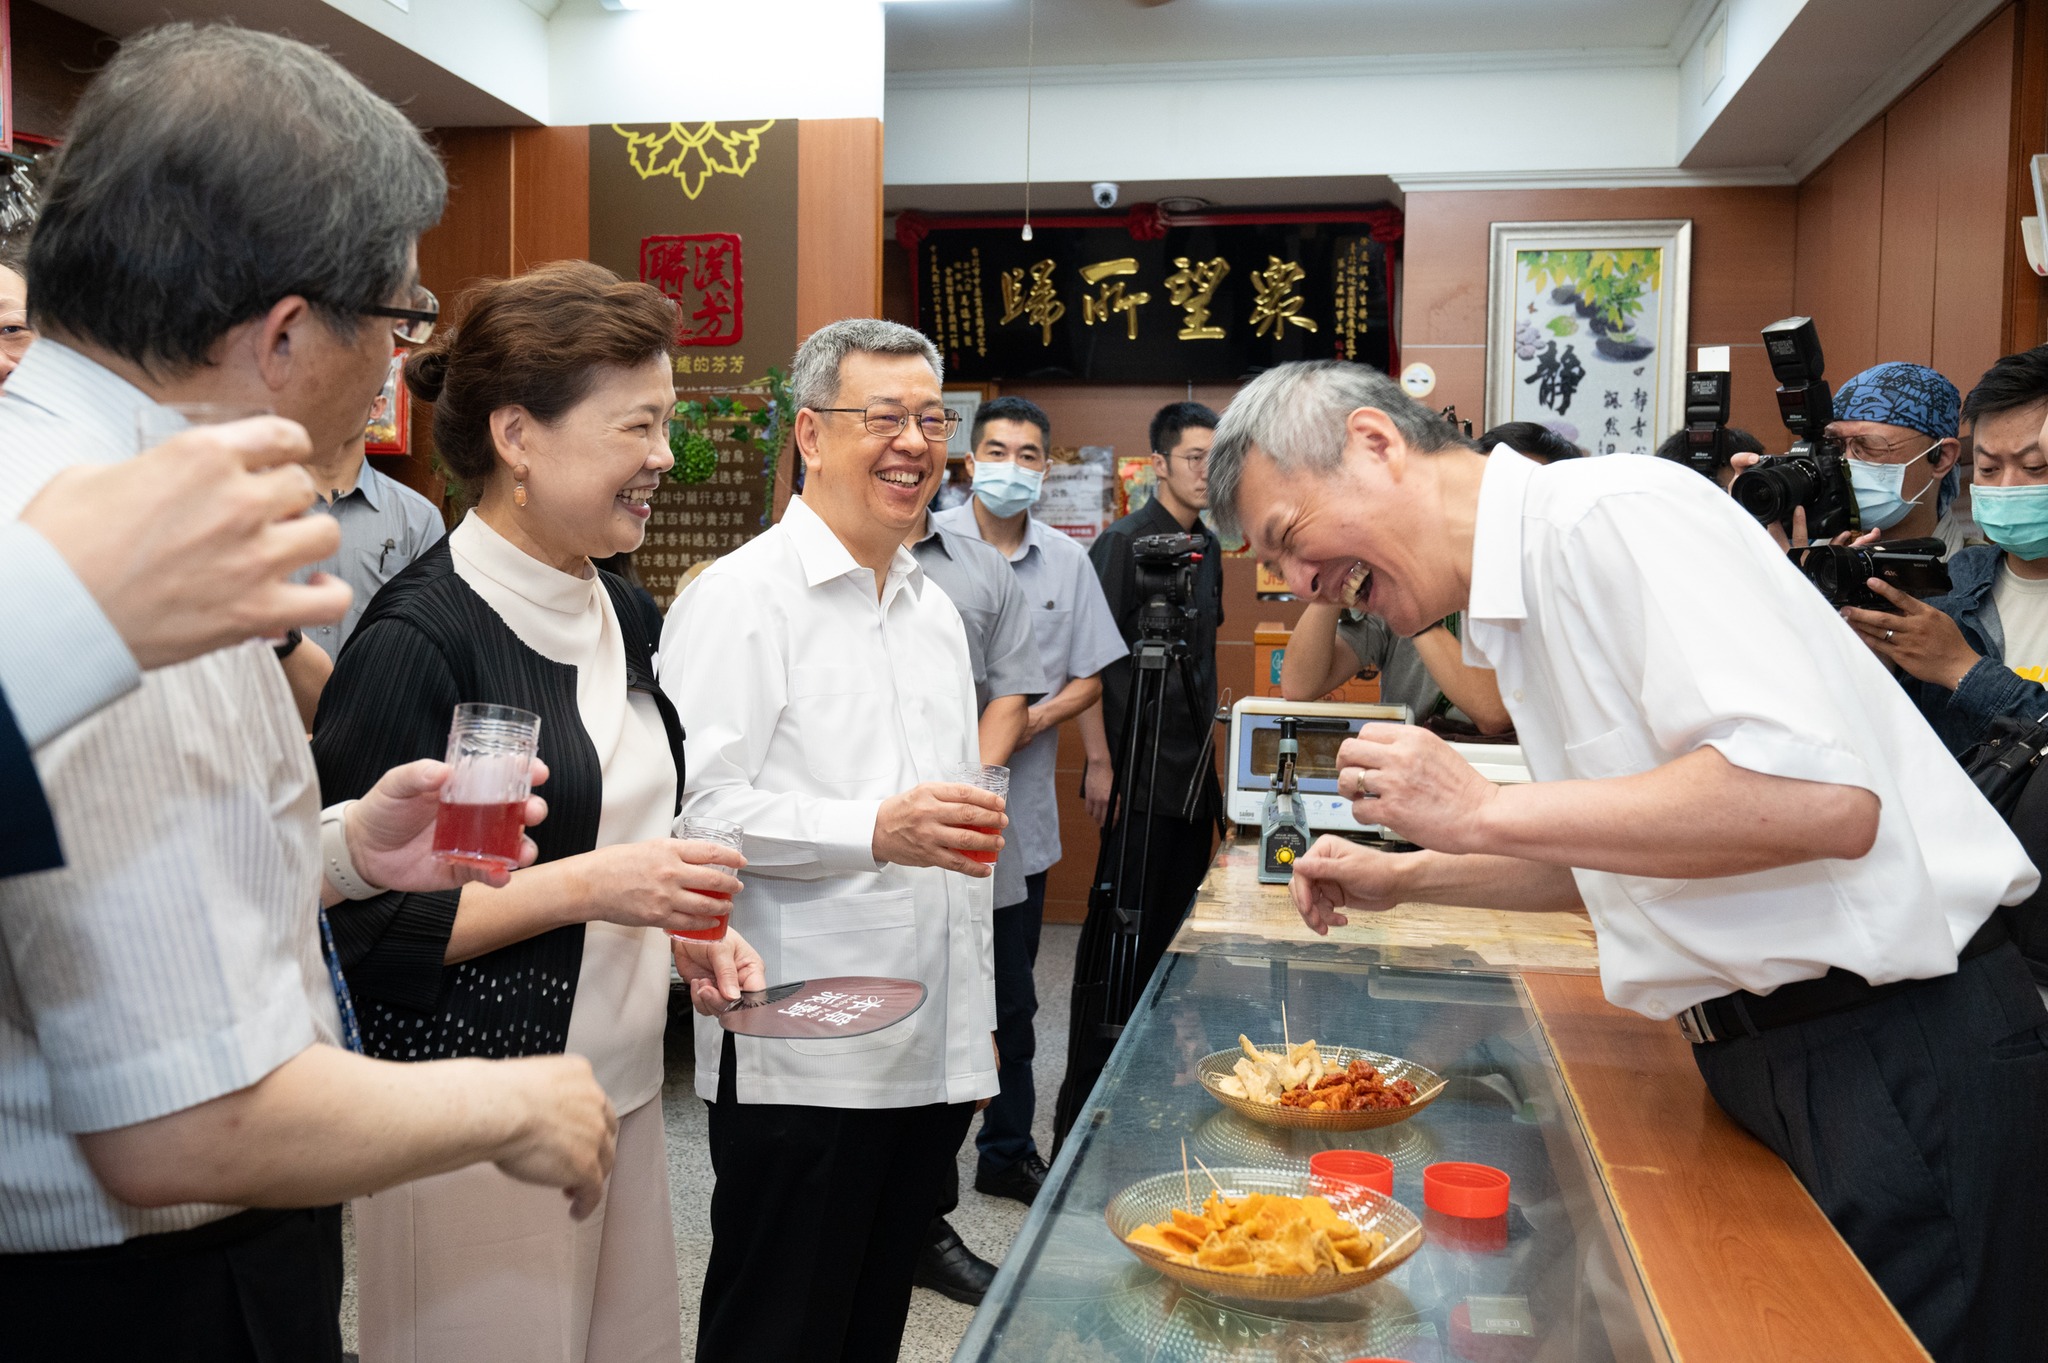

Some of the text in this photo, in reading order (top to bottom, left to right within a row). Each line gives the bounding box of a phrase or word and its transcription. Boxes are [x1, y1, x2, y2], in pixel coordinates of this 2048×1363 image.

[671, 355, 745, 374] 癒的芬芳
[1524, 340, 1586, 416] 靜
